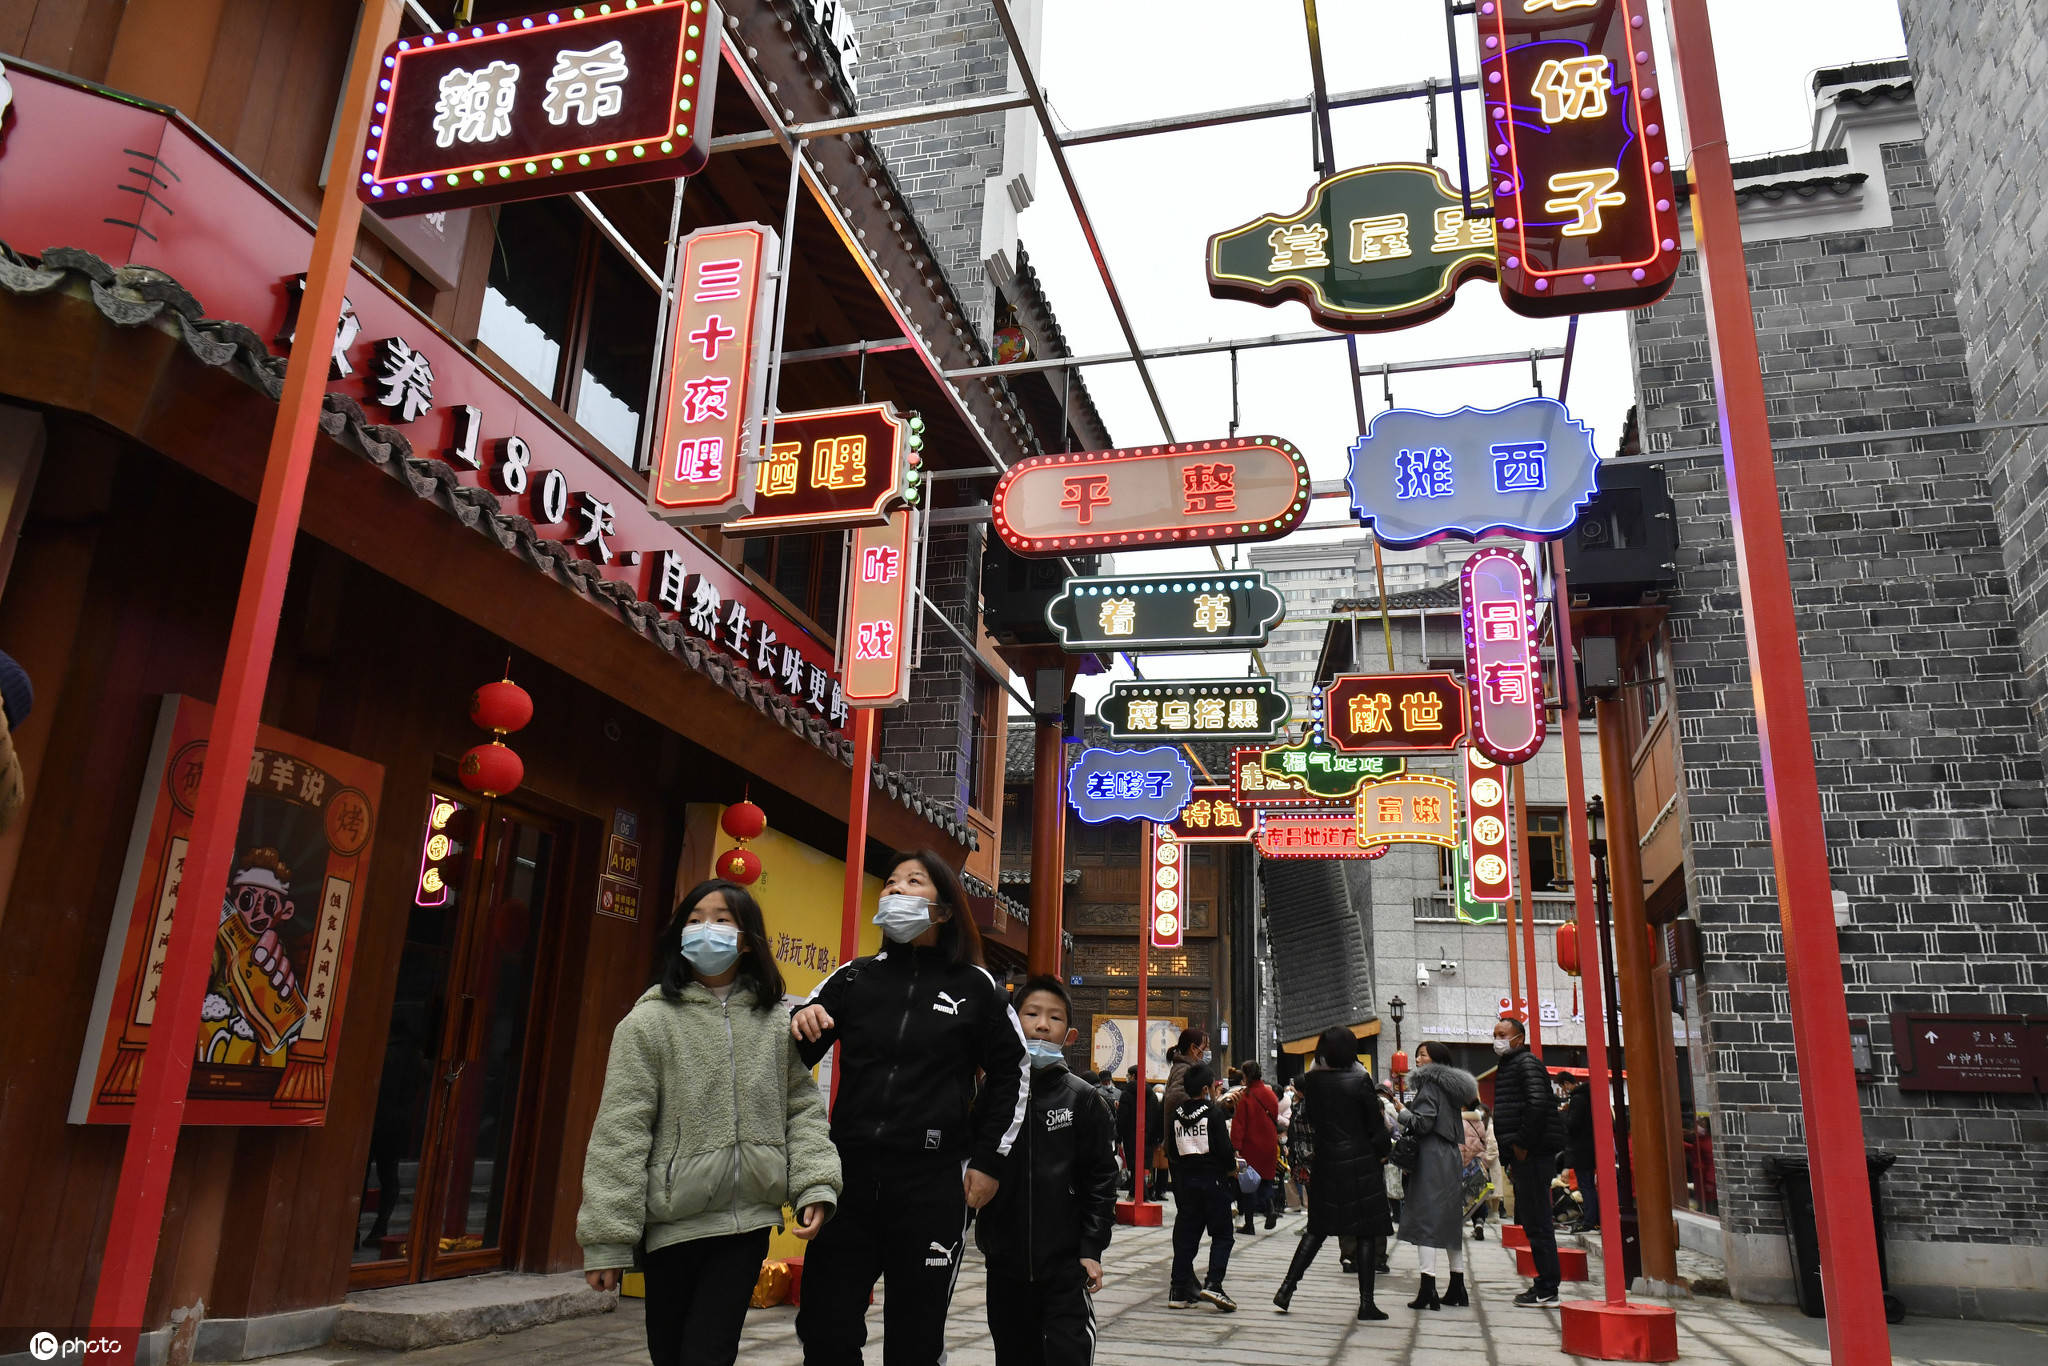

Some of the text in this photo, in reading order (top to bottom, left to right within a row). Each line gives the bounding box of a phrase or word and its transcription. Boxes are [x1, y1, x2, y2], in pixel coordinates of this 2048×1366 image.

[433, 40, 629, 148] 辣希
[1523, 0, 1626, 236] 伢子
[674, 258, 743, 482] 三十夜哩
[1059, 462, 1238, 525] 平整
[1395, 441, 1547, 499] 摊西
[856, 545, 899, 658] 咋戏
[1479, 600, 1527, 705] 冒有
[1348, 691, 1443, 734] 献世
[336, 802, 364, 843] 烤
[775, 932, 829, 974] 游玩攻略
[933, 1003, 954, 1015] PUMA
[925, 1258, 948, 1267] PUMA
